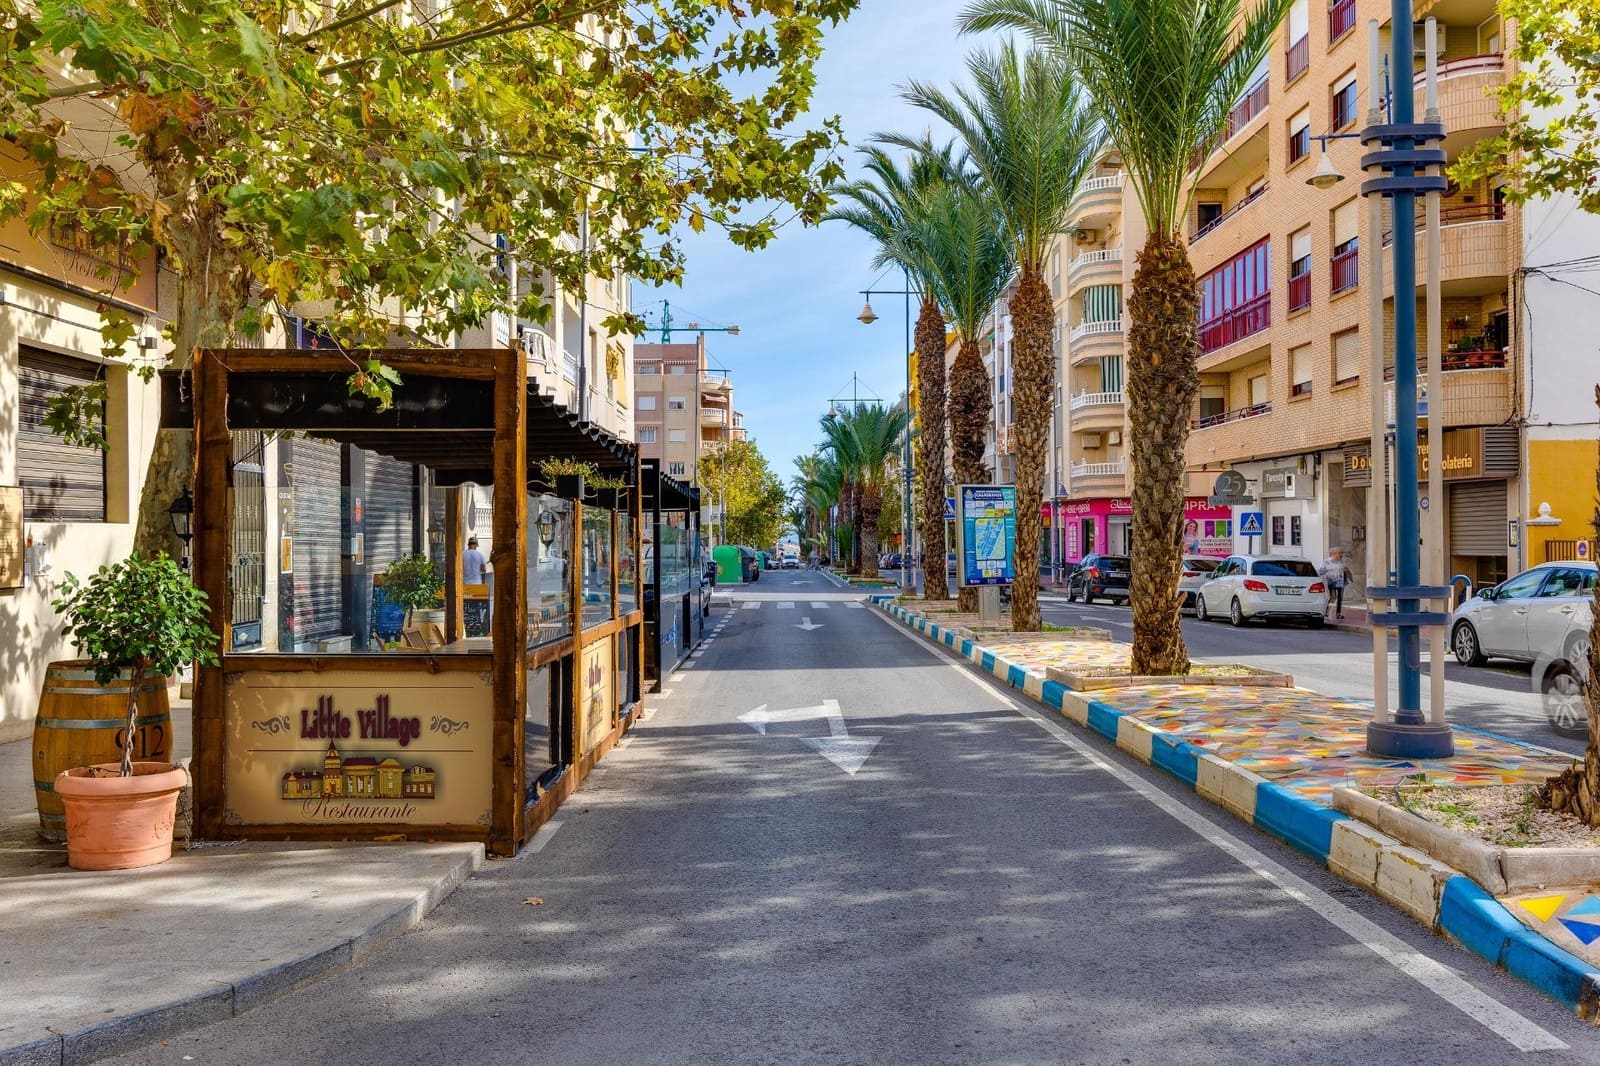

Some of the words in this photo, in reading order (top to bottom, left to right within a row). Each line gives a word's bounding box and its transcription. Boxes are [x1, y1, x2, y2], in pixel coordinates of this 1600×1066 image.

[1422, 453, 1473, 472] Colatería
[1222, 475, 1242, 495] 25
[301, 695, 351, 739] Little
[357, 694, 421, 747] Village
[301, 797, 417, 819] Restaurante
